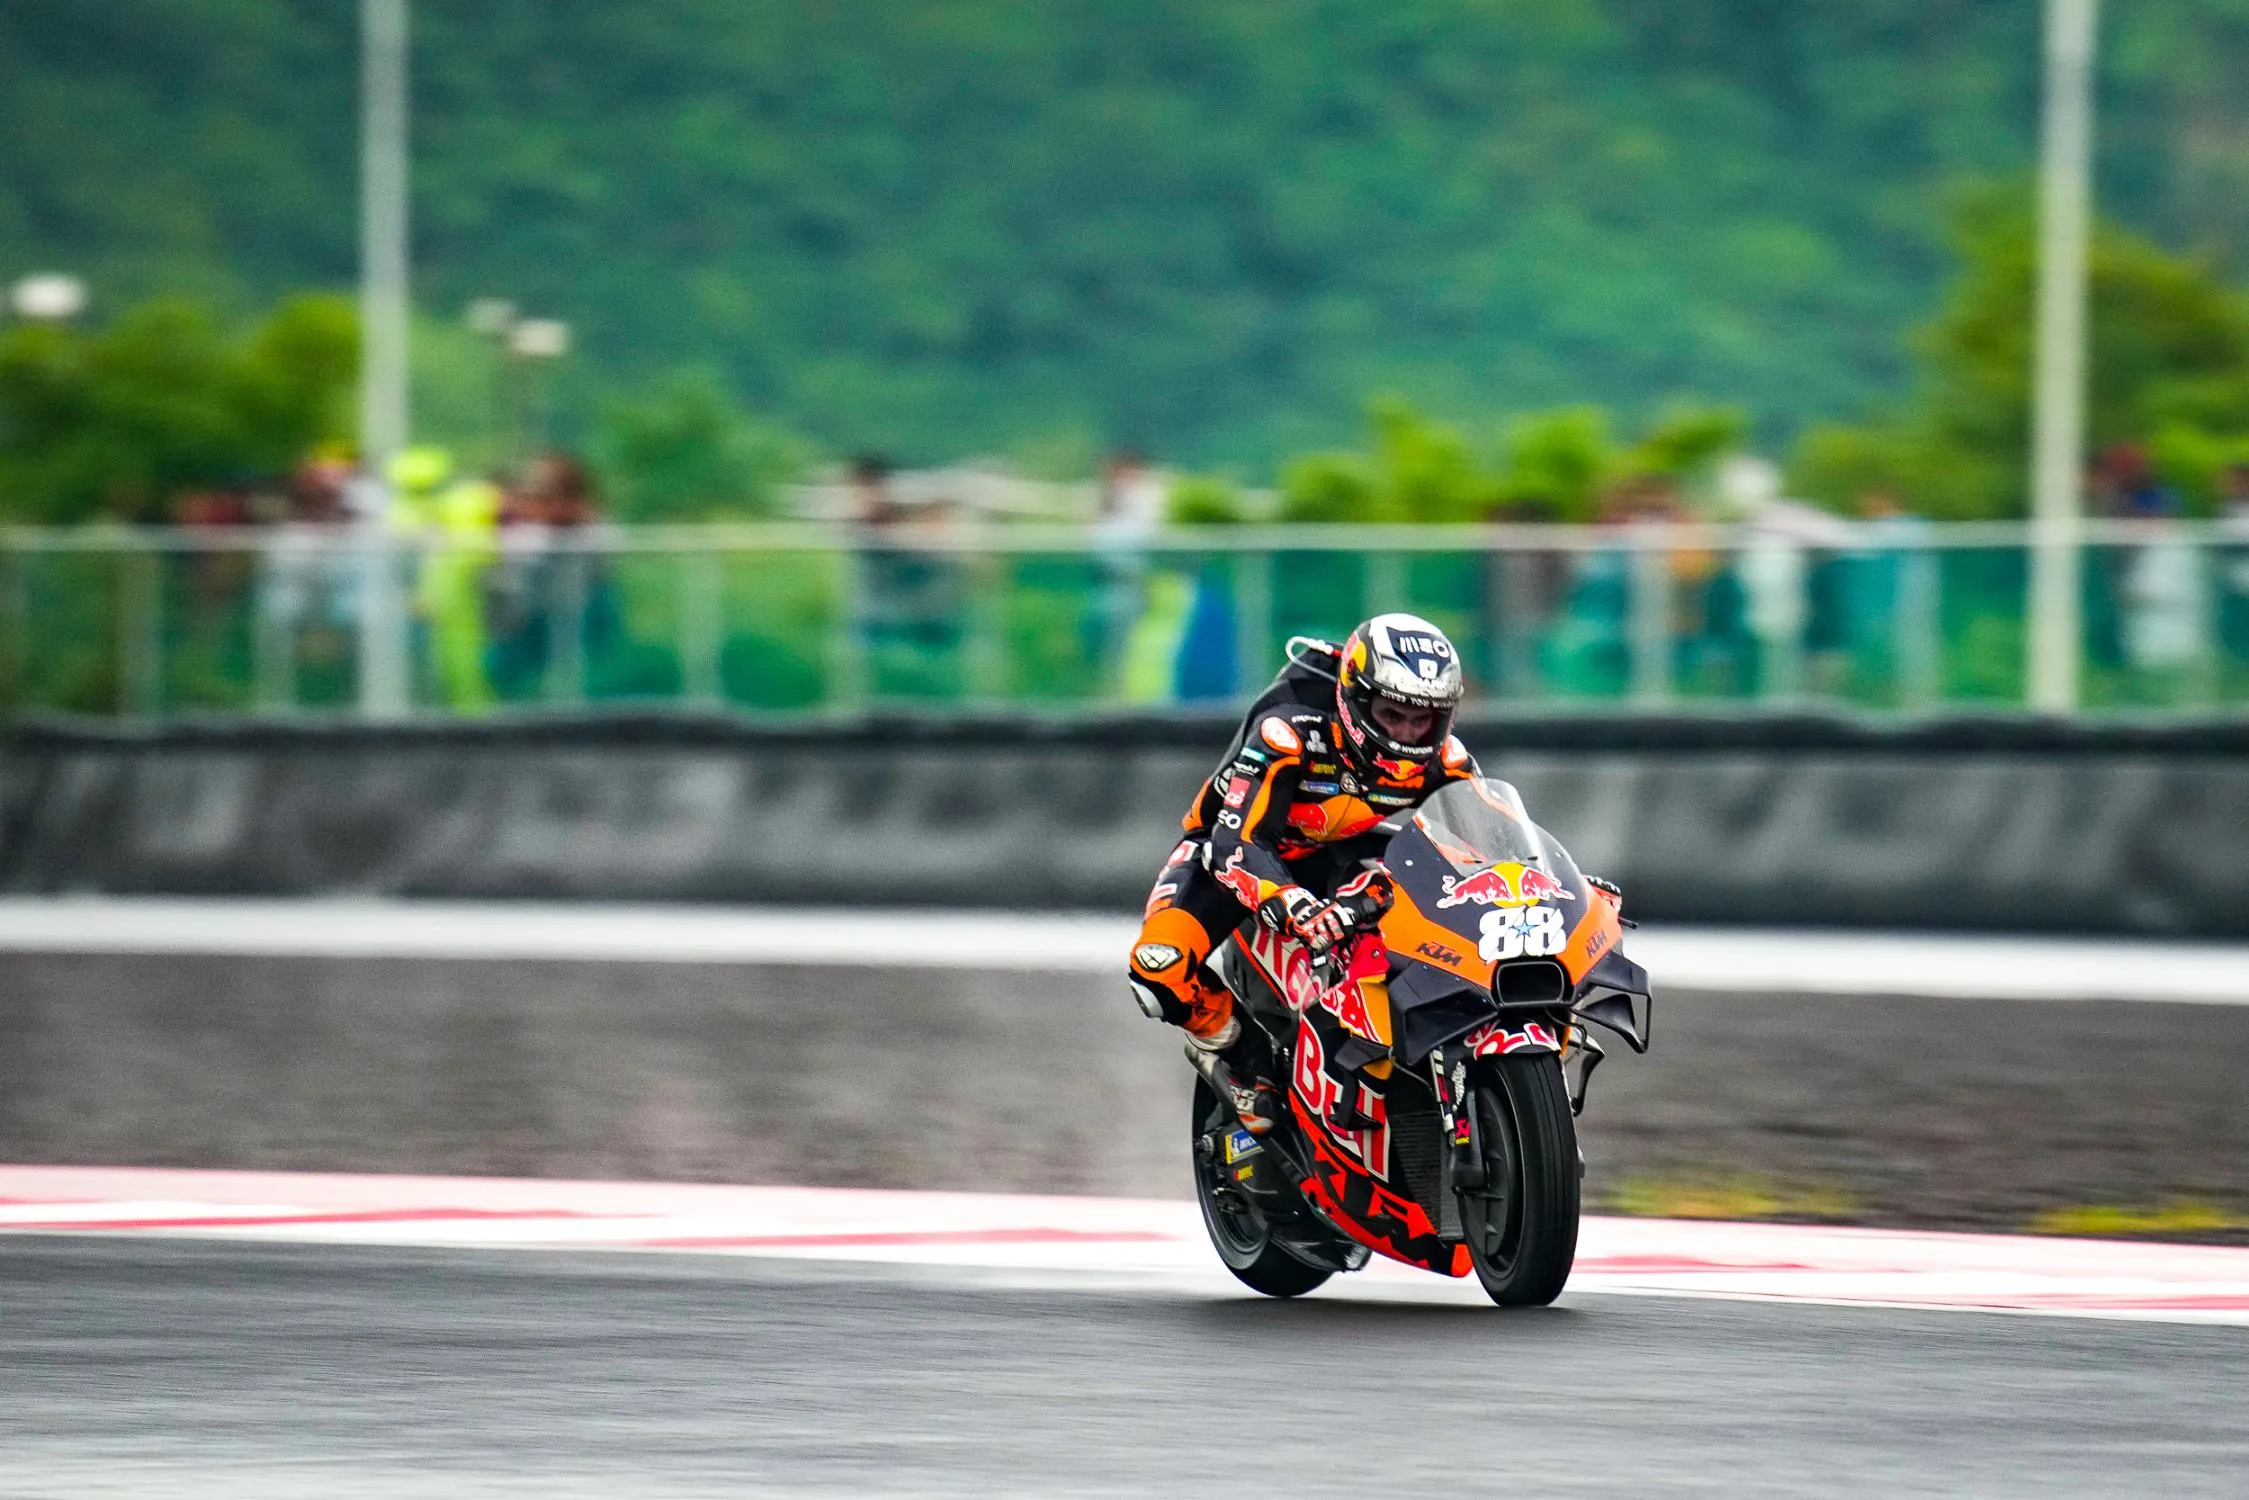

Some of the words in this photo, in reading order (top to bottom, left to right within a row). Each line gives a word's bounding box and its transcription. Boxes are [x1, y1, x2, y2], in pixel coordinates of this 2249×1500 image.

[1478, 905, 1566, 964] 88
[1585, 929, 1608, 959] KTM
[1416, 941, 1463, 967] KTM
